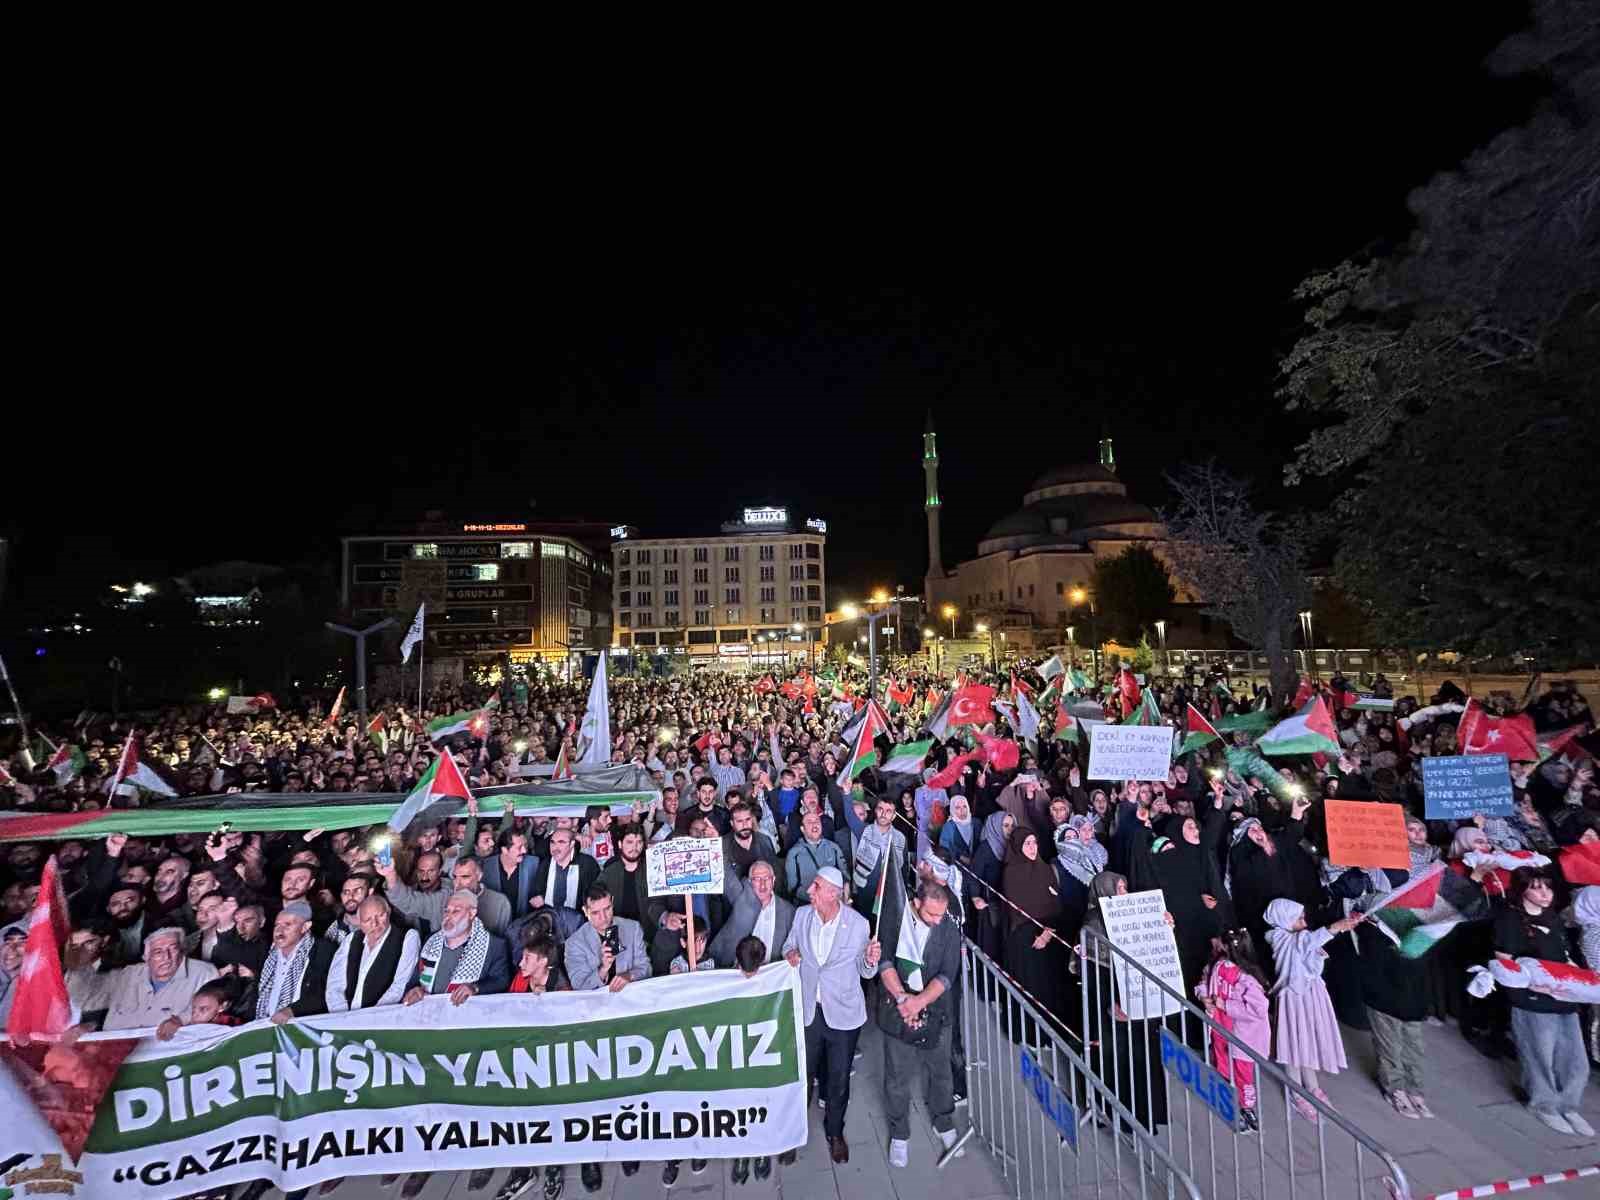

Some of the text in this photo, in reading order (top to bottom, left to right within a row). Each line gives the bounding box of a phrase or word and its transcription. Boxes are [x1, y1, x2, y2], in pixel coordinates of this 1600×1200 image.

[113, 1020, 782, 1132] DİRENİŞİN YANINDAYIZ
[1161, 1033, 1236, 1124] POLİS
[282, 1126, 404, 1171] HALKI
[415, 1119, 553, 1151] YALNIZ
[563, 1101, 768, 1142] DEĞİLDİR!”
